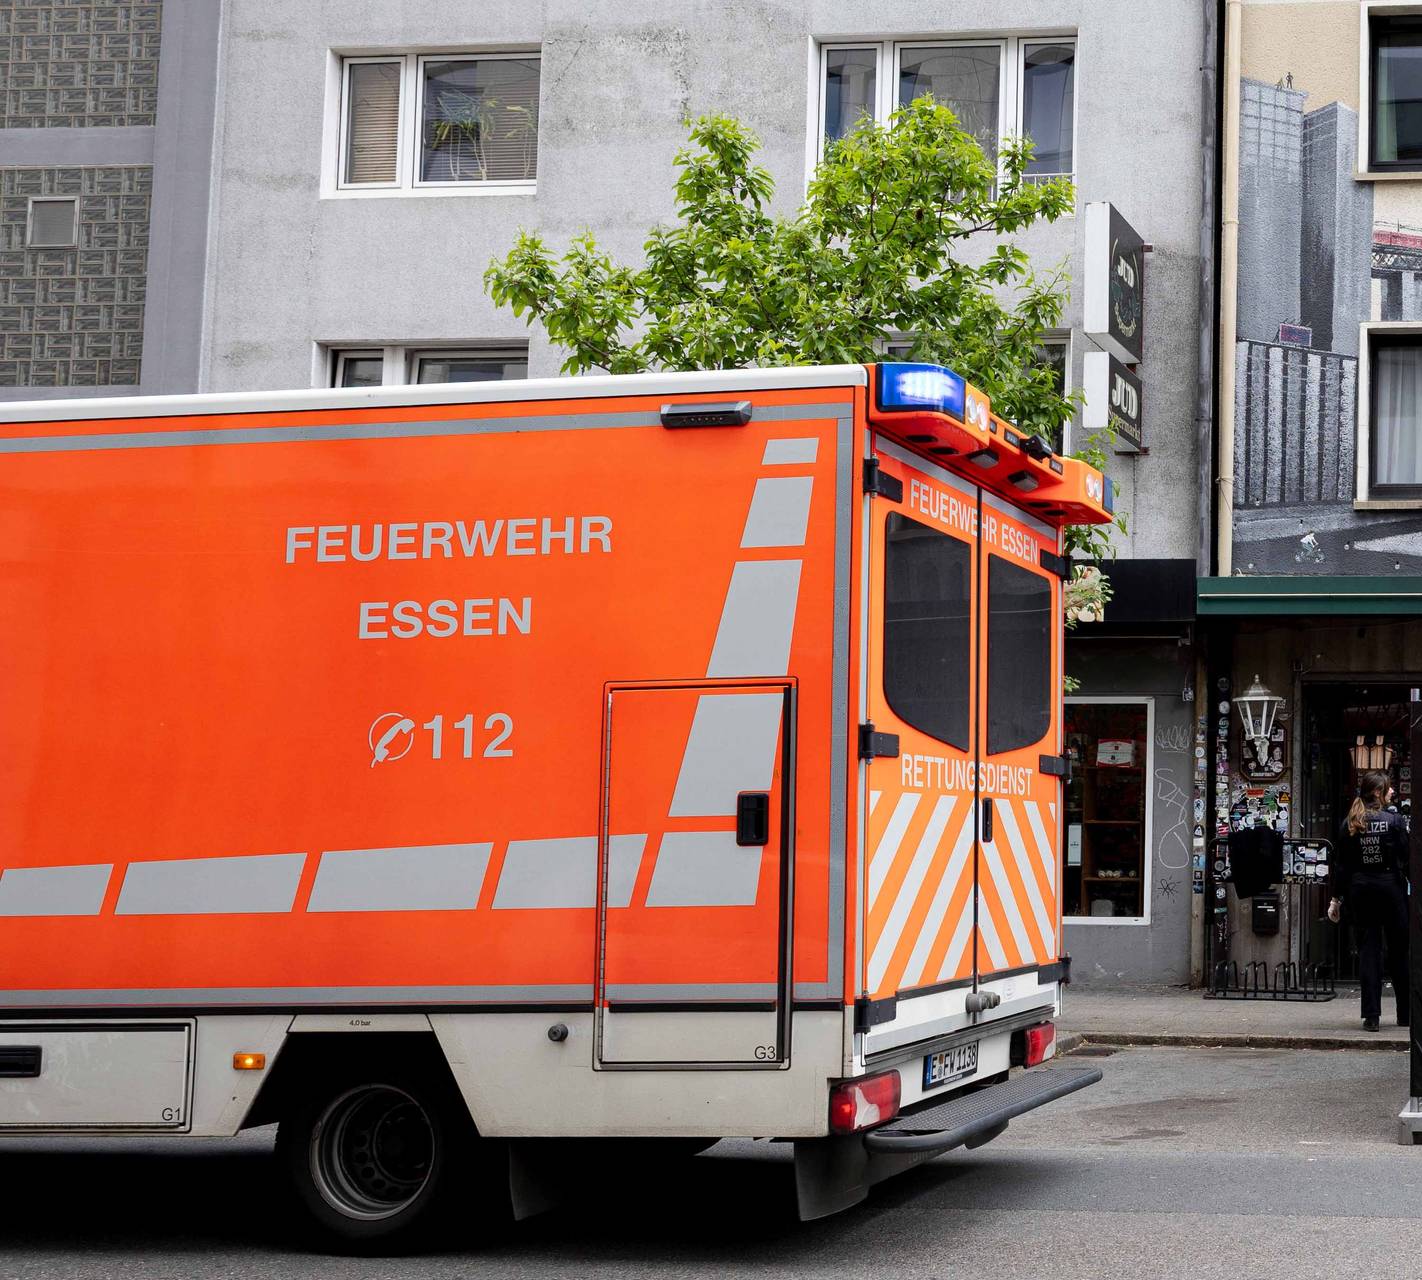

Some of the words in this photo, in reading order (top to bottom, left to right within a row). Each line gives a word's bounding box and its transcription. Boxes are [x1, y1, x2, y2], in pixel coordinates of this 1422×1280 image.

[1111, 372, 1138, 420] JUD
[285, 515, 614, 564] FEUERWEHR
[910, 478, 998, 545] FEUERWEHR
[1001, 523, 1039, 565] ESSEN
[358, 597, 533, 640] ESSEN
[423, 712, 514, 760] 112
[901, 752, 1033, 796] RETTUNGSDIENST
[1360, 821, 1389, 834] LIZEI
[1360, 836, 1380, 845] NRW
[1362, 846, 1381, 855] 282
[754, 1045, 776, 1060] G3
[161, 1107, 180, 1121] G1
